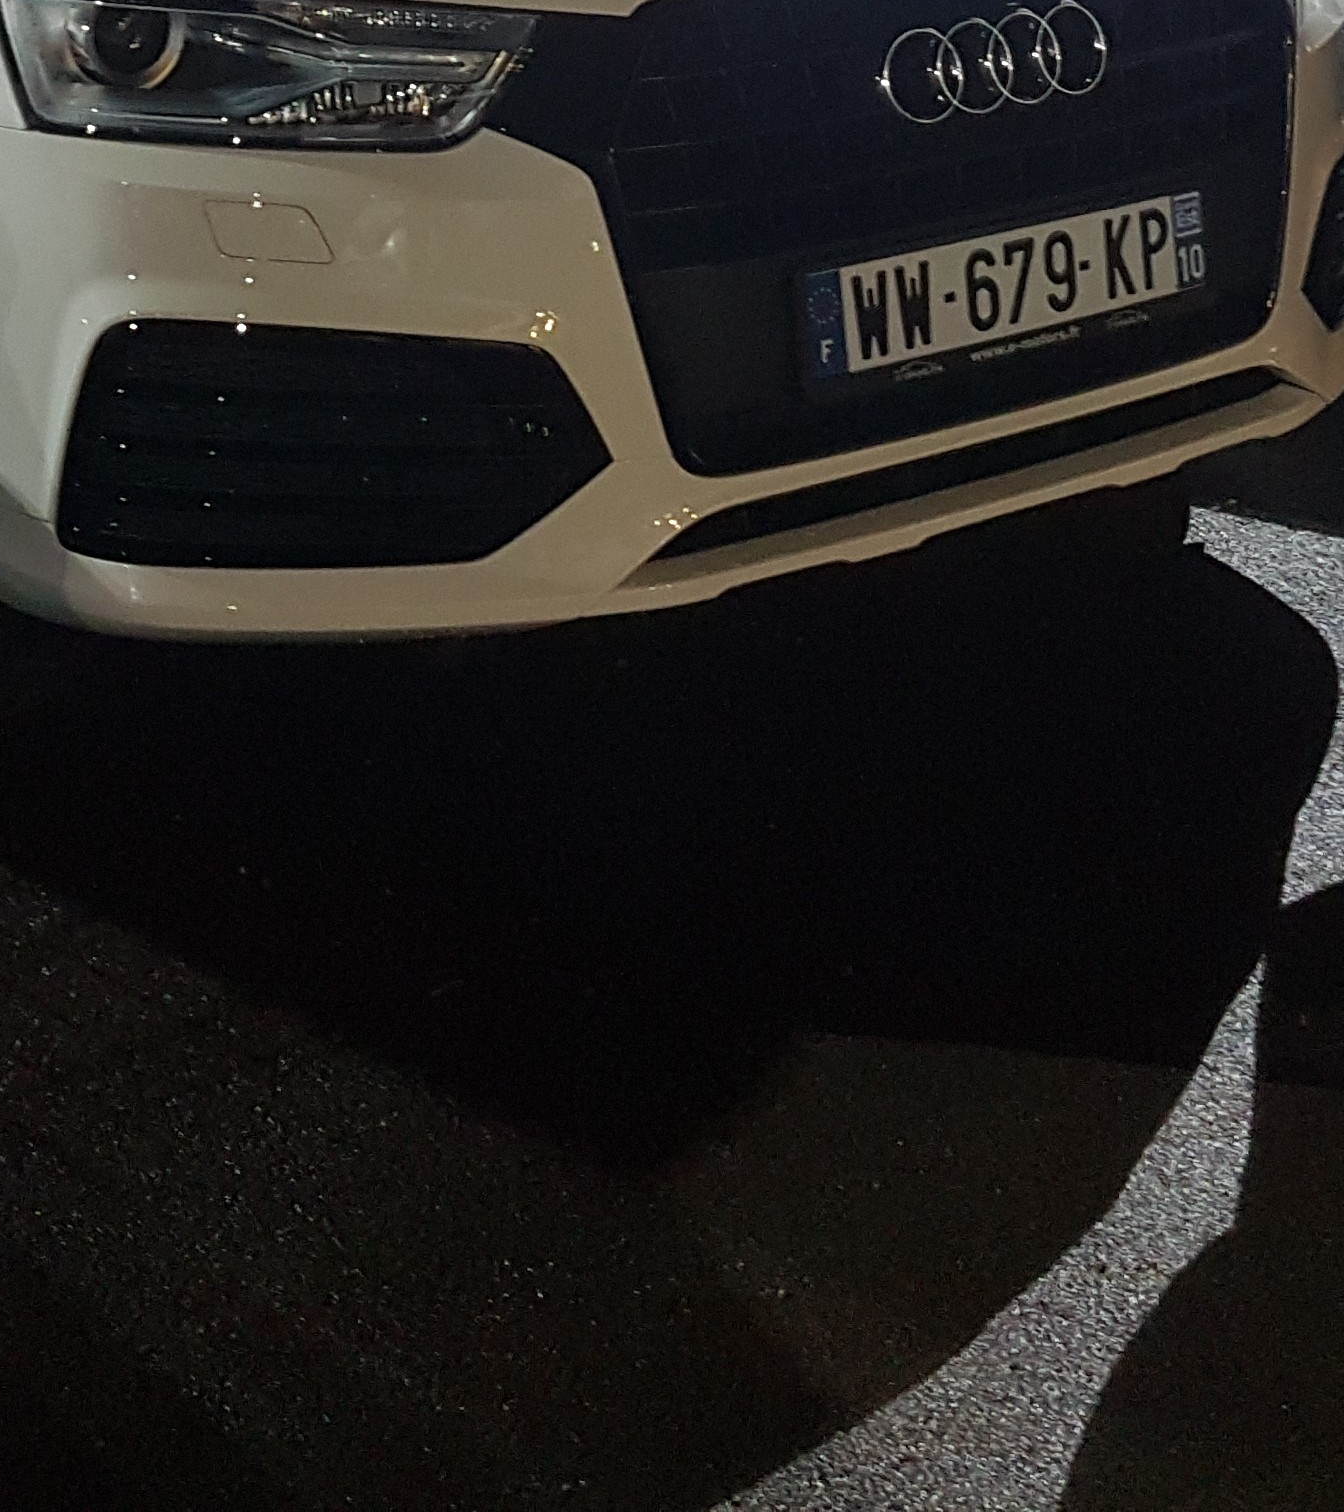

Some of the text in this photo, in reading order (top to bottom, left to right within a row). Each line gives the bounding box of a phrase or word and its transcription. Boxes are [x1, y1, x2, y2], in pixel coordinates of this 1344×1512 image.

[819, 338, 834, 364] F
[852, 207, 1169, 360] WW-679-KP
[1178, 244, 1205, 283] 10
